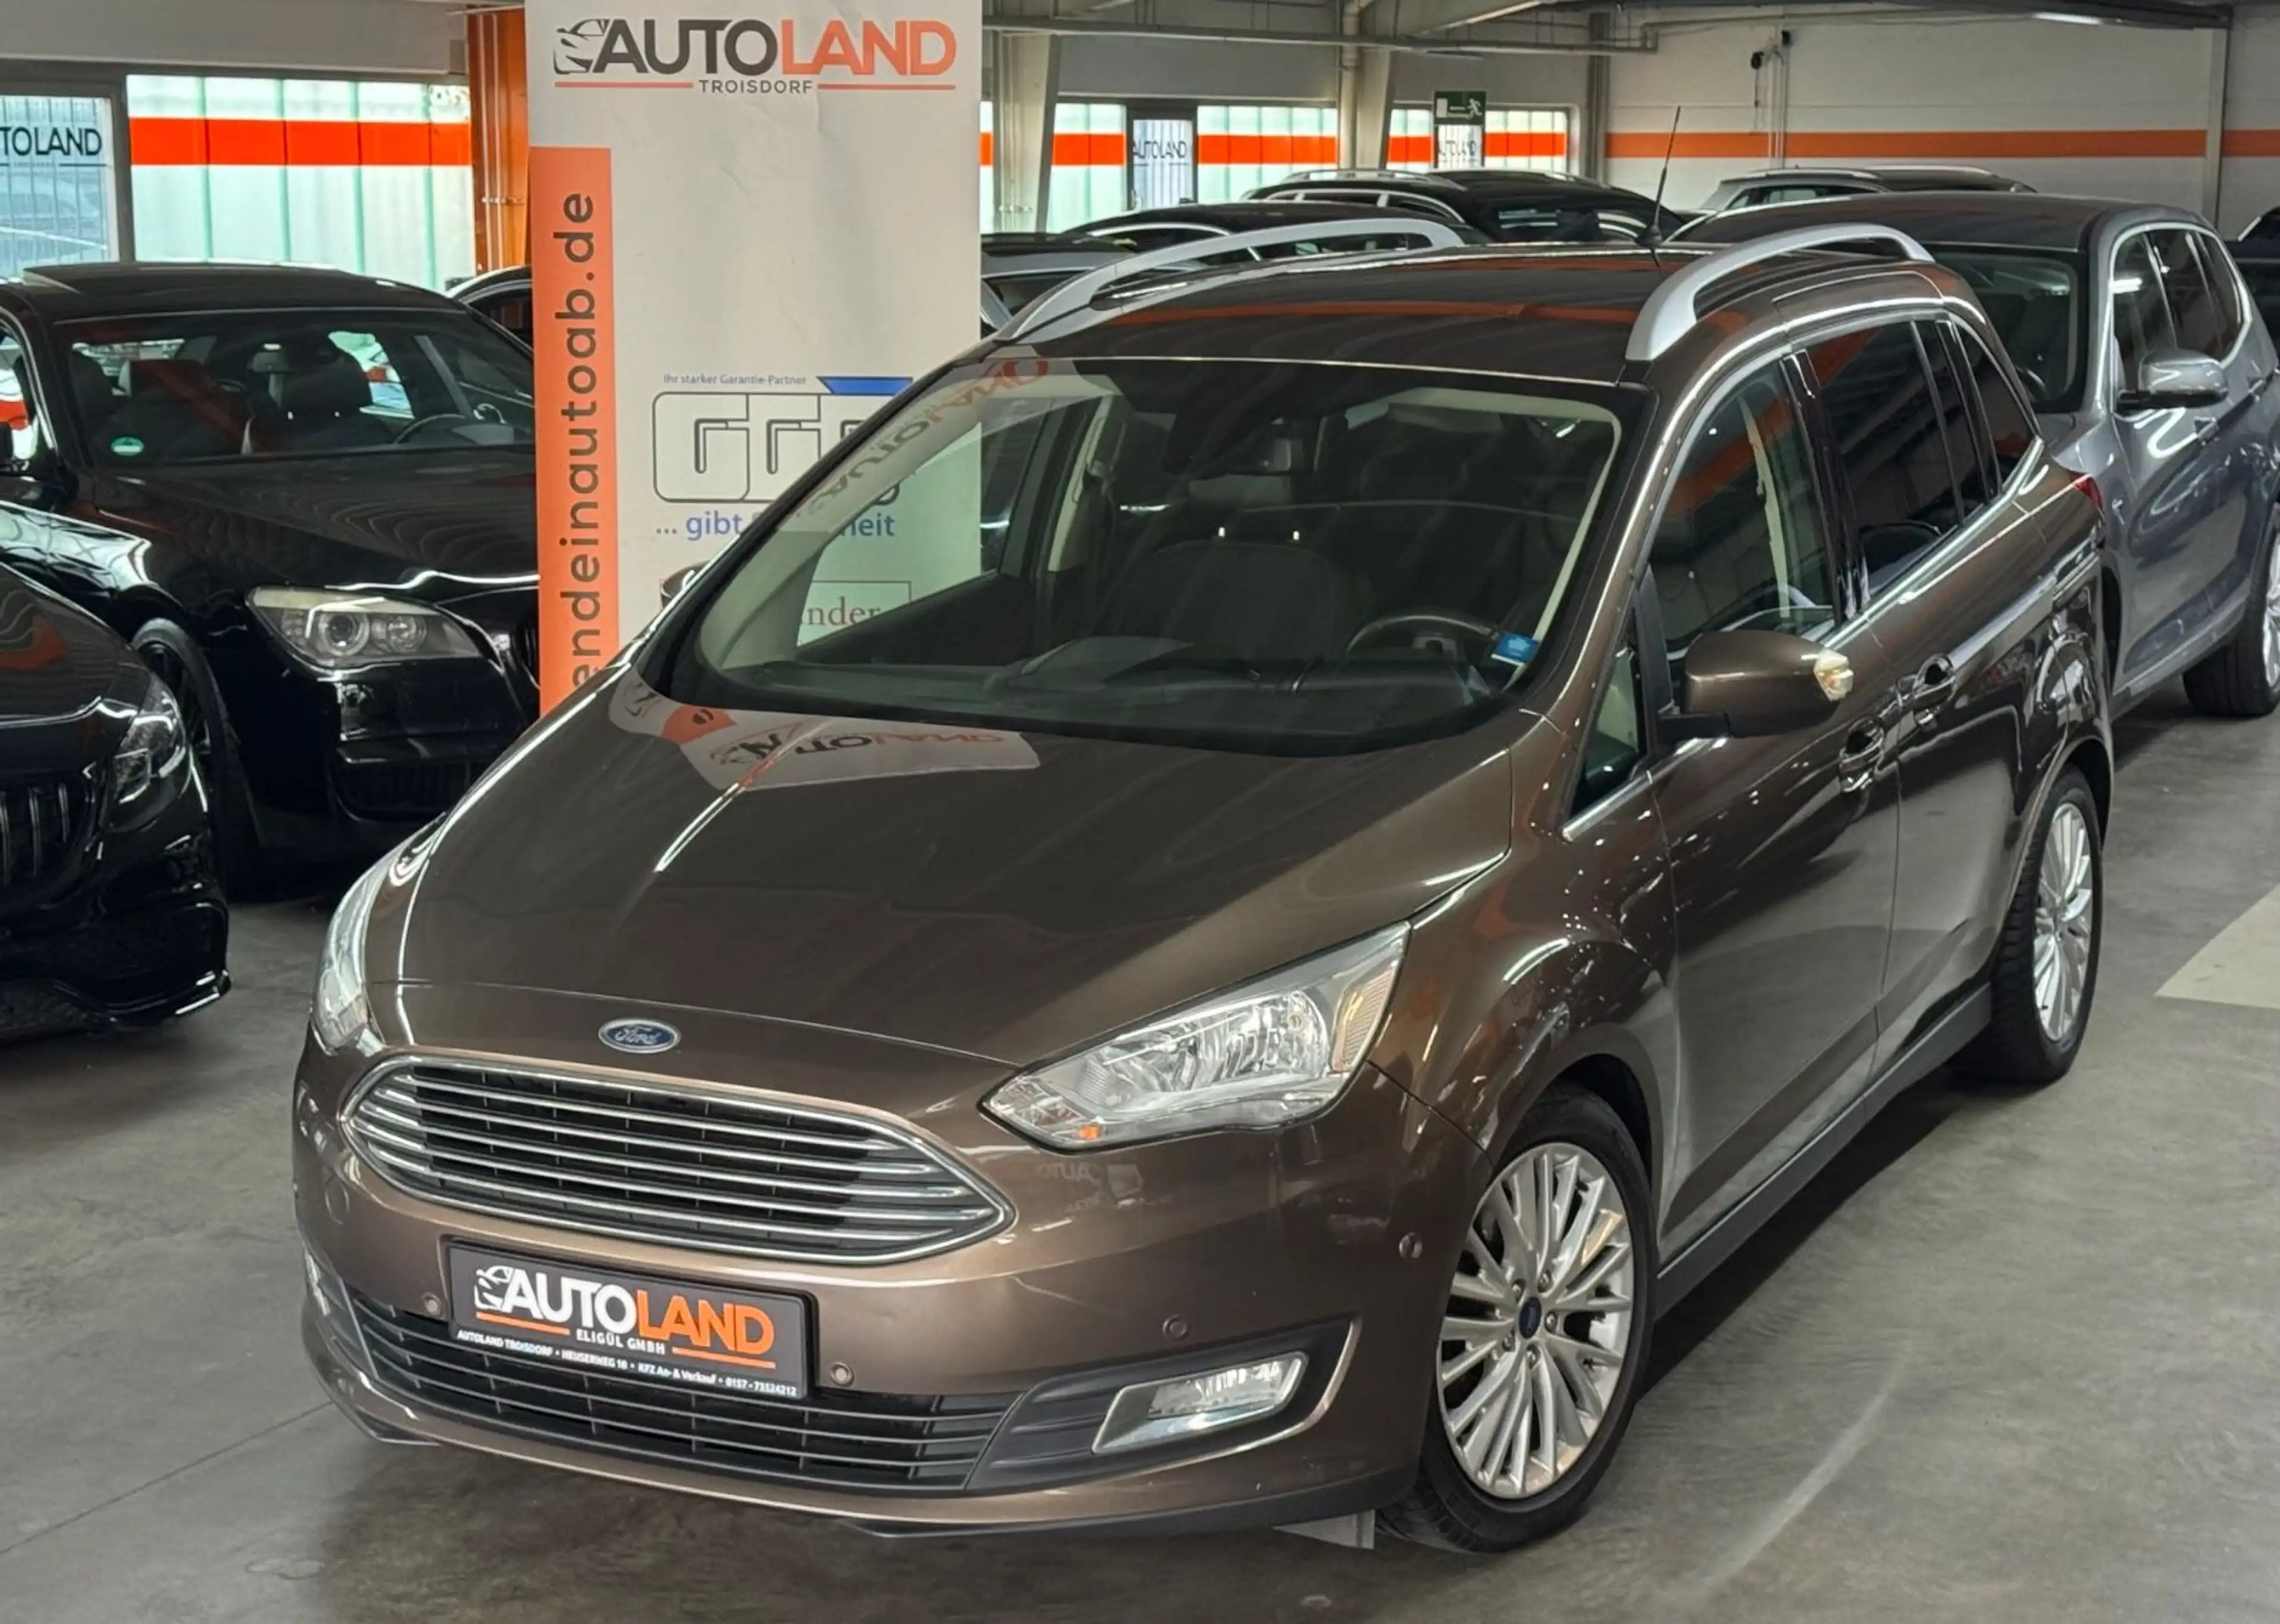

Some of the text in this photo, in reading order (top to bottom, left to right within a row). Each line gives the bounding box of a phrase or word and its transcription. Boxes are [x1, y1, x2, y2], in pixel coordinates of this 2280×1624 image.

[592, 20, 957, 76] AUTOLAND
[698, 80, 813, 94] TROISDORF
[663, 375, 679, 383] Ihr
[680, 374, 717, 385] starker
[686, 510, 743, 541] gibt
[614, 1026, 663, 1045] Ford
[501, 1268, 775, 1355] AUTOLAND
[457, 1329, 504, 1347] AUTOLAND
[626, 1337, 666, 1355] GMBH
